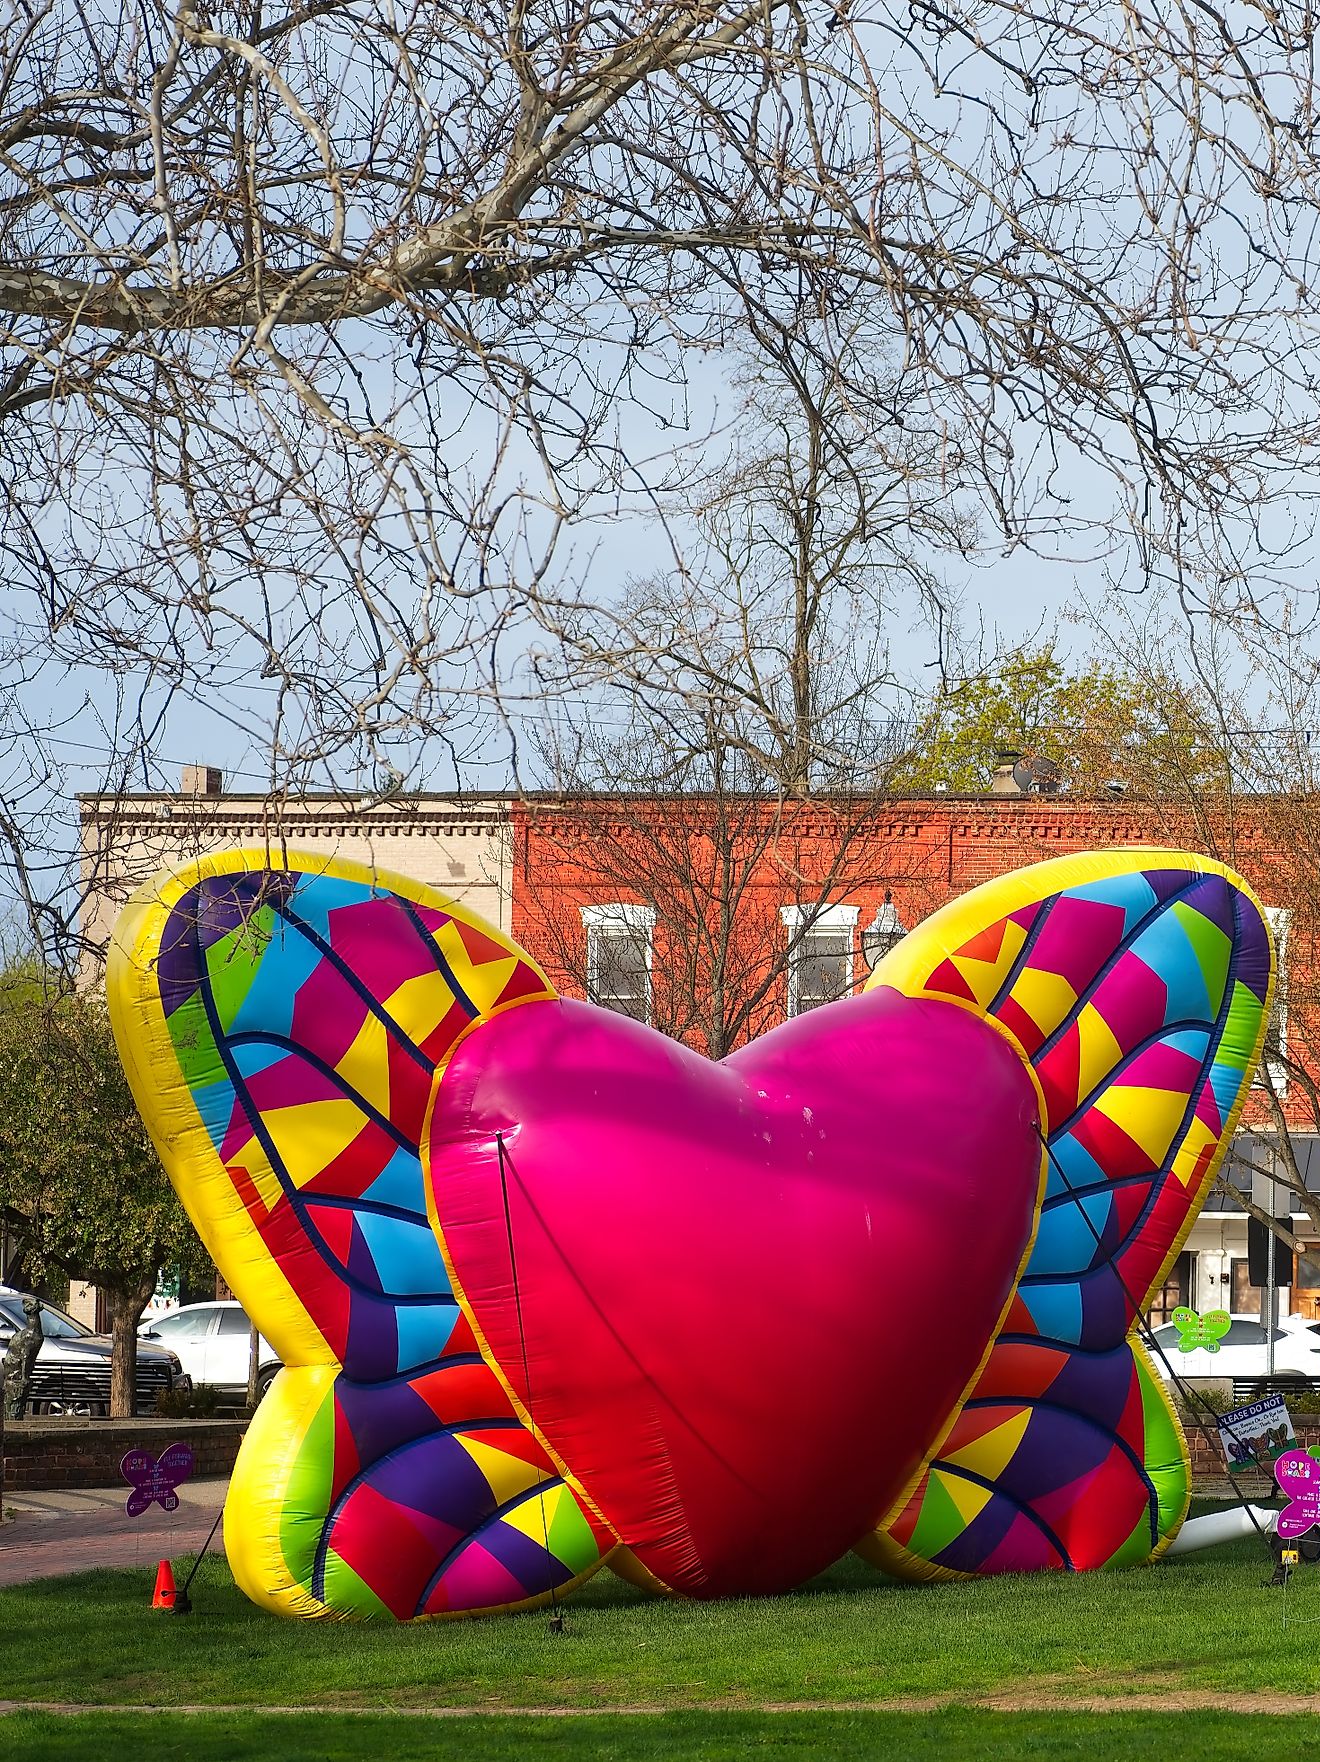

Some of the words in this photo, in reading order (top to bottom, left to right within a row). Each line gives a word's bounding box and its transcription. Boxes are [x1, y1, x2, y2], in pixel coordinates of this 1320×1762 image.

[1250, 1405, 1262, 1414] DO
[1264, 1397, 1280, 1409] NOT
[1282, 1460, 1311, 1471] HOPE
[1282, 1469, 1310, 1478] SOARS
